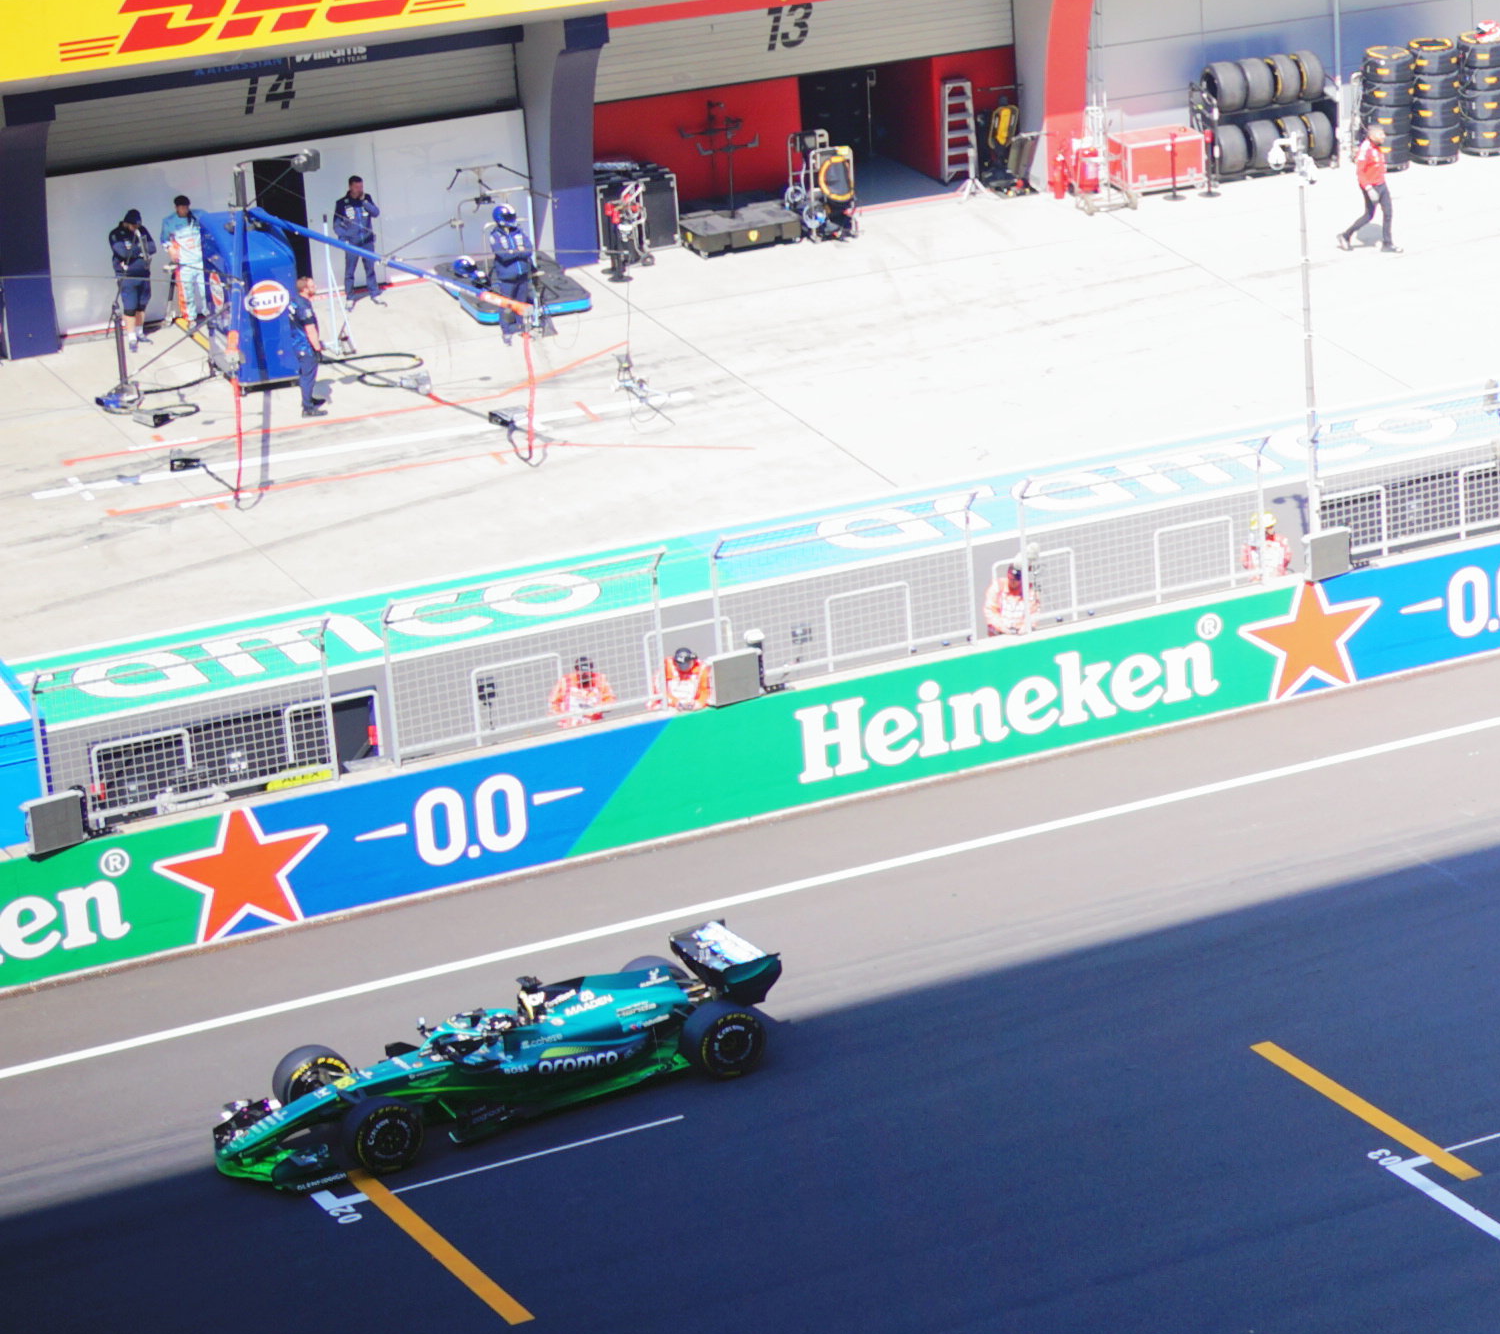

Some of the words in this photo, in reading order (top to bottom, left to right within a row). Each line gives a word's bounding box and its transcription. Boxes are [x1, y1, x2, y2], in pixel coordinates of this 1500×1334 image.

[767, 1, 813, 51] 13
[347, 54, 367, 63] TEAM
[245, 70, 296, 115] 14
[249, 294, 287, 308] Gulf
[72, 573, 602, 699] amco
[795, 637, 1220, 785] Heineken
[282, 771, 321, 785] ALEX
[565, 993, 614, 1016] MAADEN
[529, 1033, 564, 1047] cohere
[504, 1064, 530, 1076] BOSS
[538, 1049, 620, 1076] aramco
